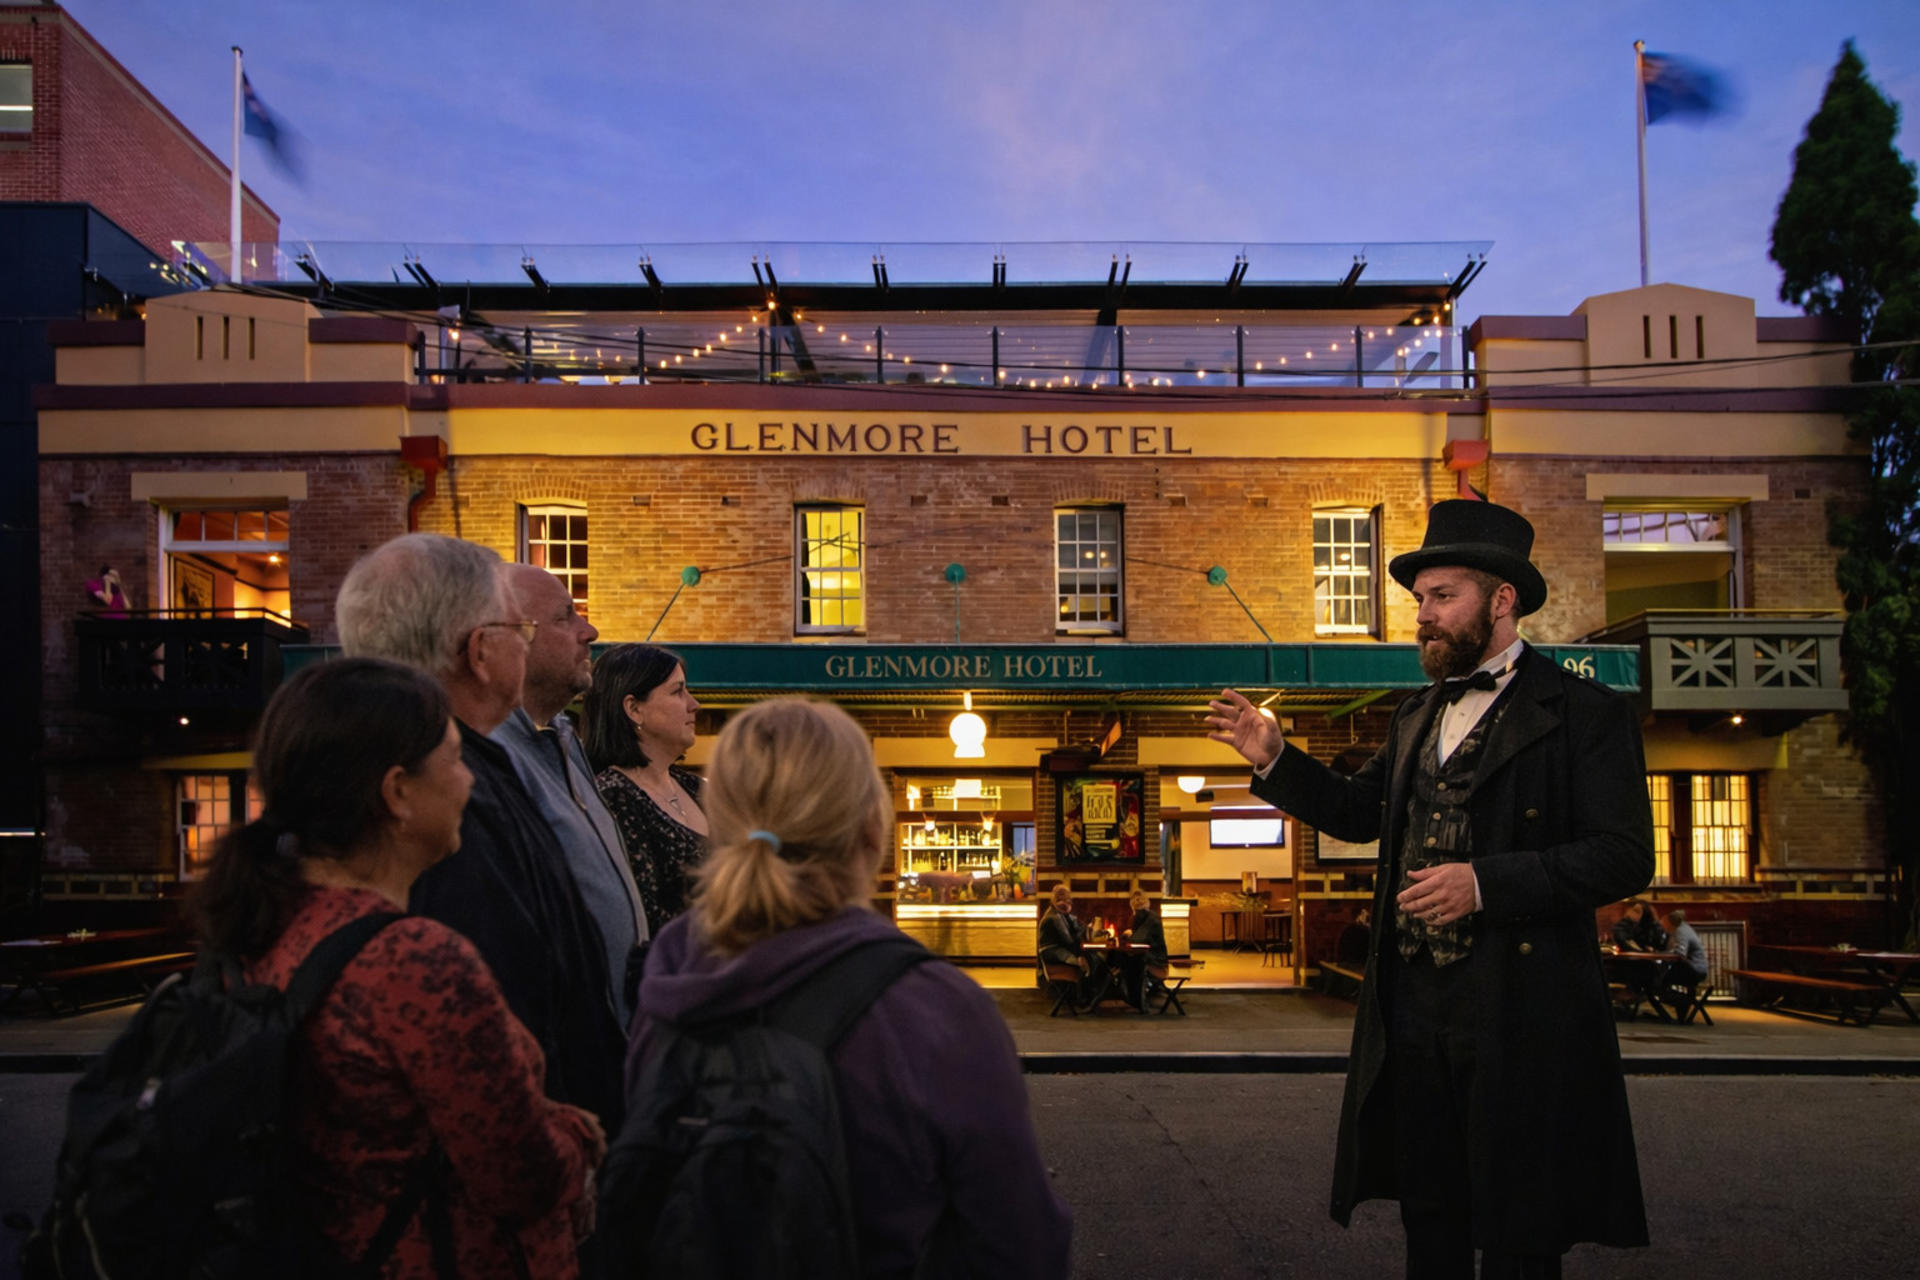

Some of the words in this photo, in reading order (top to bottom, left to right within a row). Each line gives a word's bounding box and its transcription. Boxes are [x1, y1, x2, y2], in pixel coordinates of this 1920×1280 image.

[691, 423, 959, 453] GLENMORE
[1022, 425, 1192, 454] HOTEL
[825, 655, 992, 678] GLENMORE
[1003, 655, 1103, 678] HOTEL
